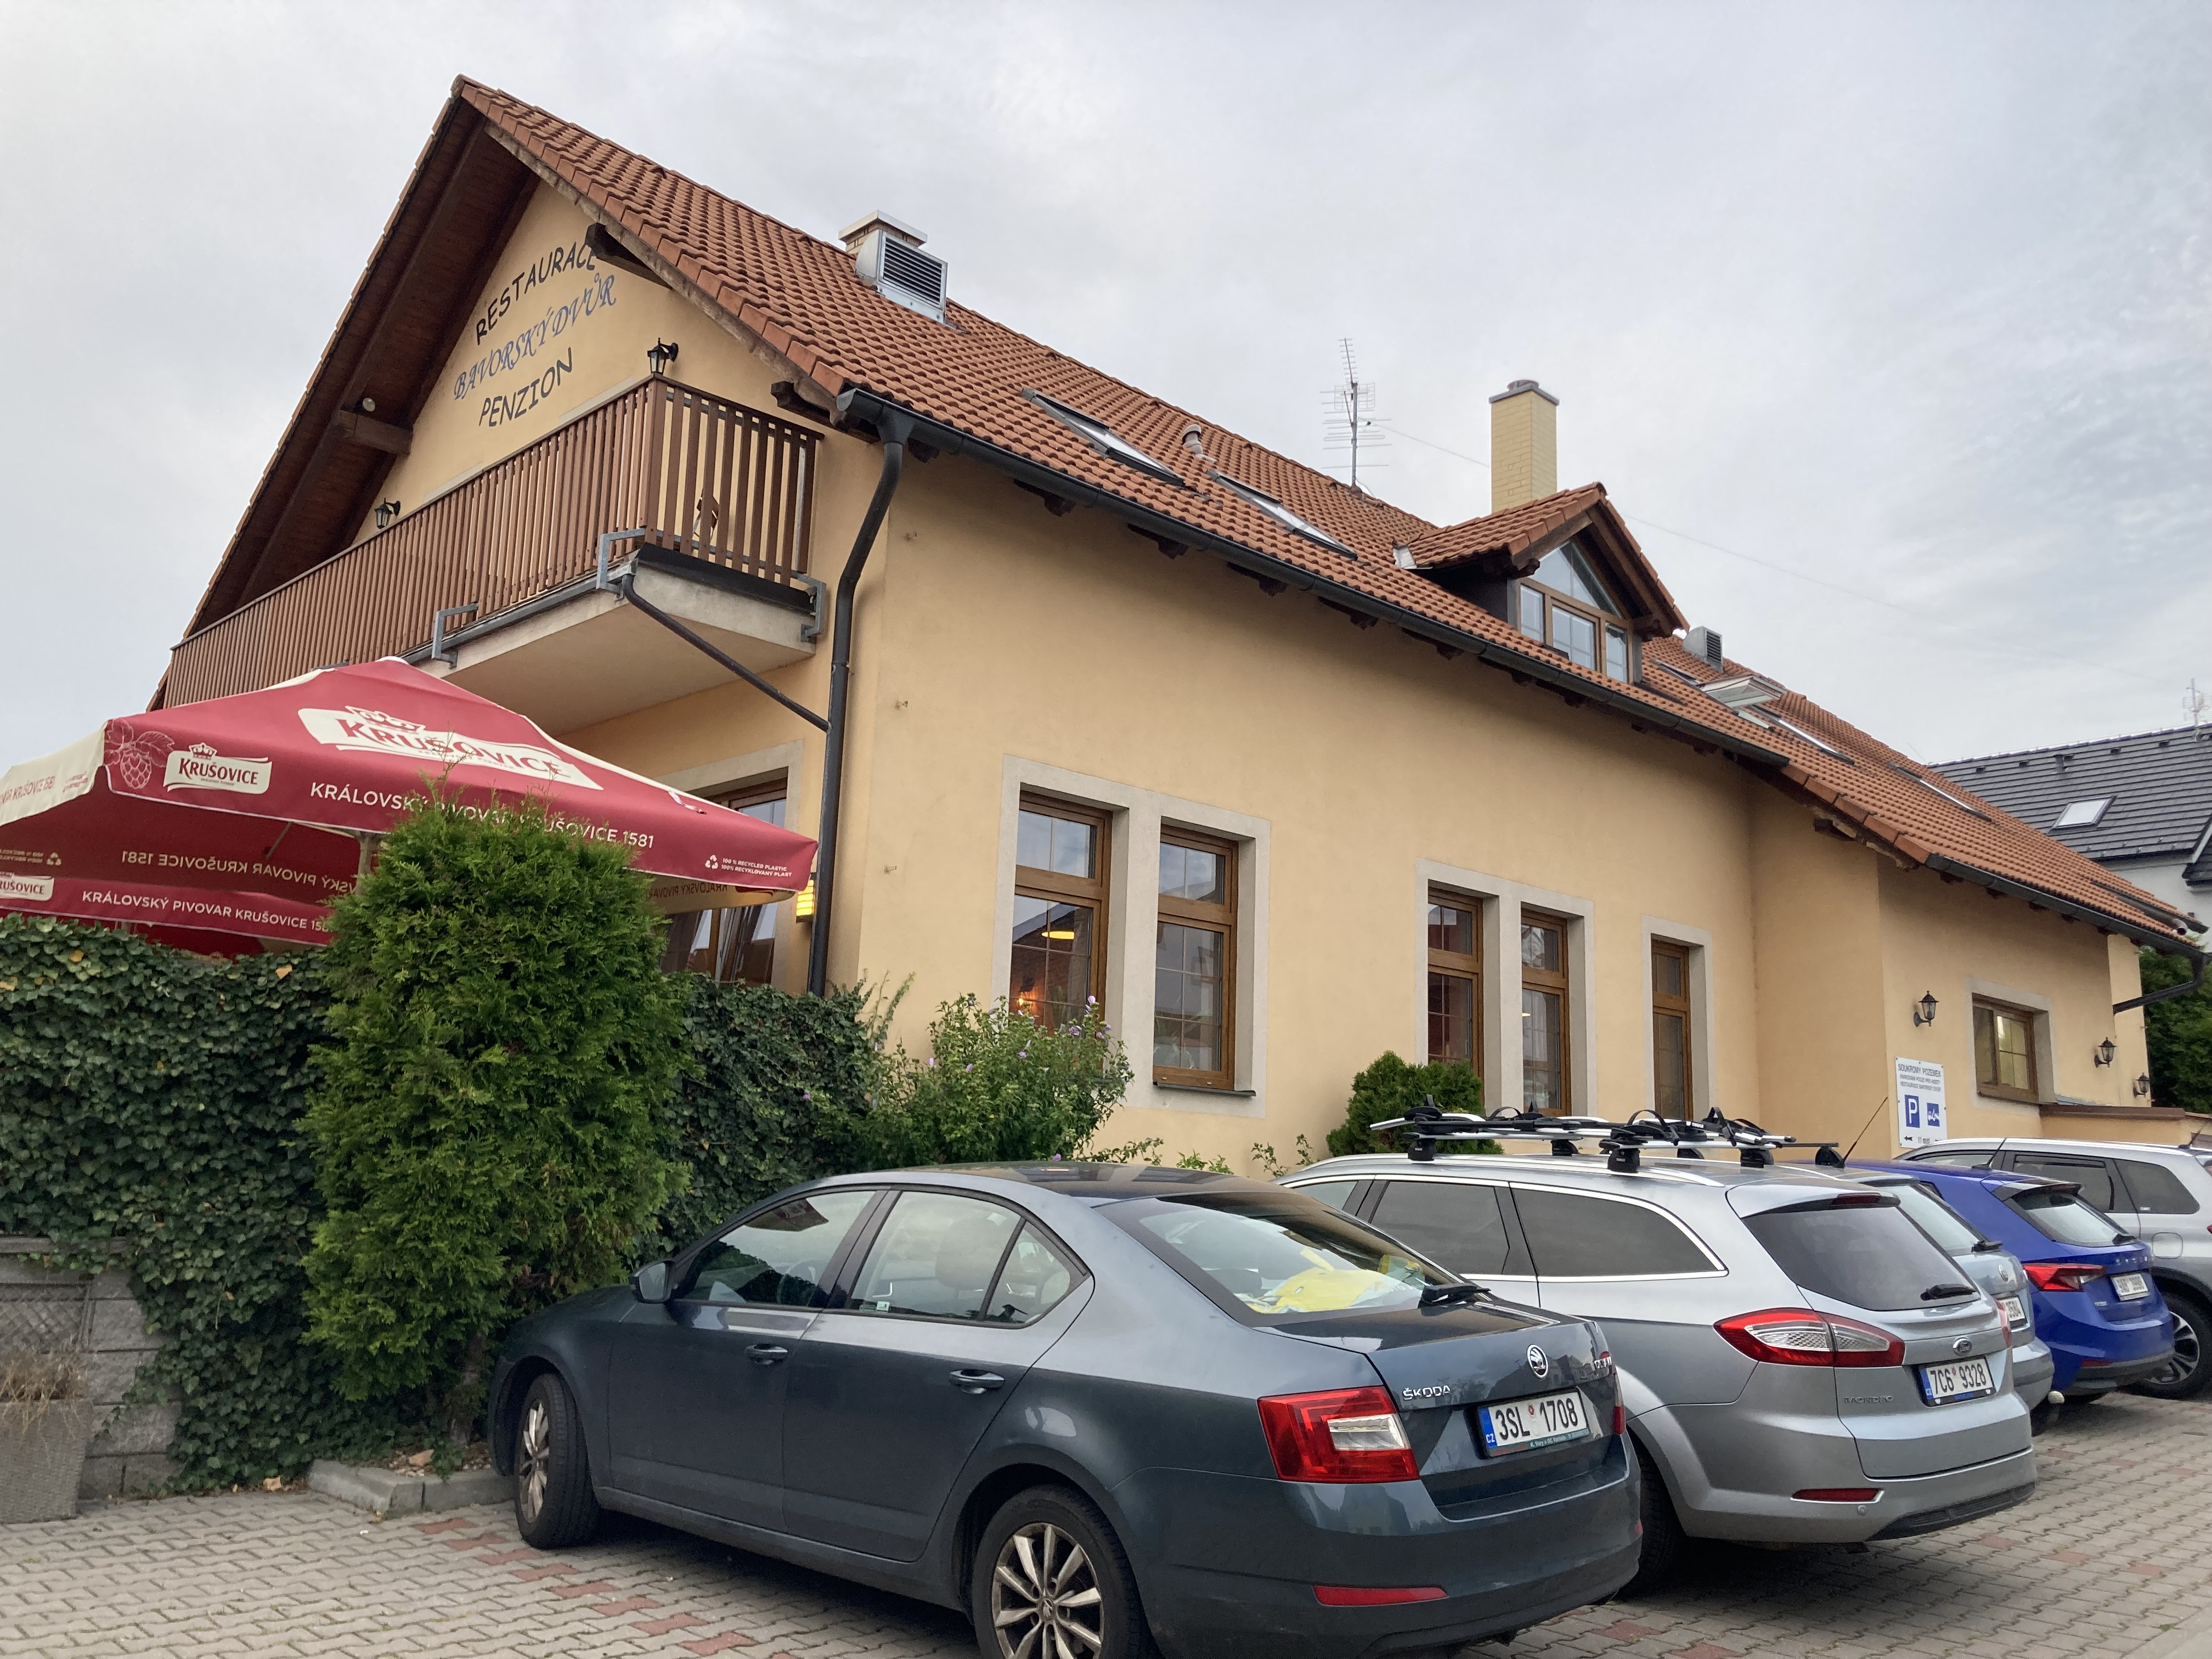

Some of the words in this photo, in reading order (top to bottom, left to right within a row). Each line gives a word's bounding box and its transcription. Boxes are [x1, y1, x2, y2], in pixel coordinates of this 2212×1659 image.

[454, 306, 554, 400] BAVORSKÝ
[552, 273, 617, 337] DVŮR
[478, 347, 572, 427] PENZION
[335, 718, 572, 778] KRUŠOVICE
[178, 757, 258, 785] KRUŠOVICE
[519, 814, 618, 843] UŠOVICE
[622, 831, 654, 849] 1581
[738, 860, 764, 869] RECYCLED
[82, 890, 170, 910] KRÁLOVSKÝ
[172, 900, 232, 918] PIVOVAR
[235, 908, 308, 929] KRUŠOVICE
[1908, 1098, 1917, 1124] P
[1403, 1384, 1451, 1401] ŠKODA
[1929, 1368, 1954, 1395] 7C6
[1959, 1363, 1987, 1389] 9328
[1496, 1406, 1531, 1441] 3SL
[1540, 1398, 1578, 1432] 1708
[1486, 1433, 1496, 1443] CZ
